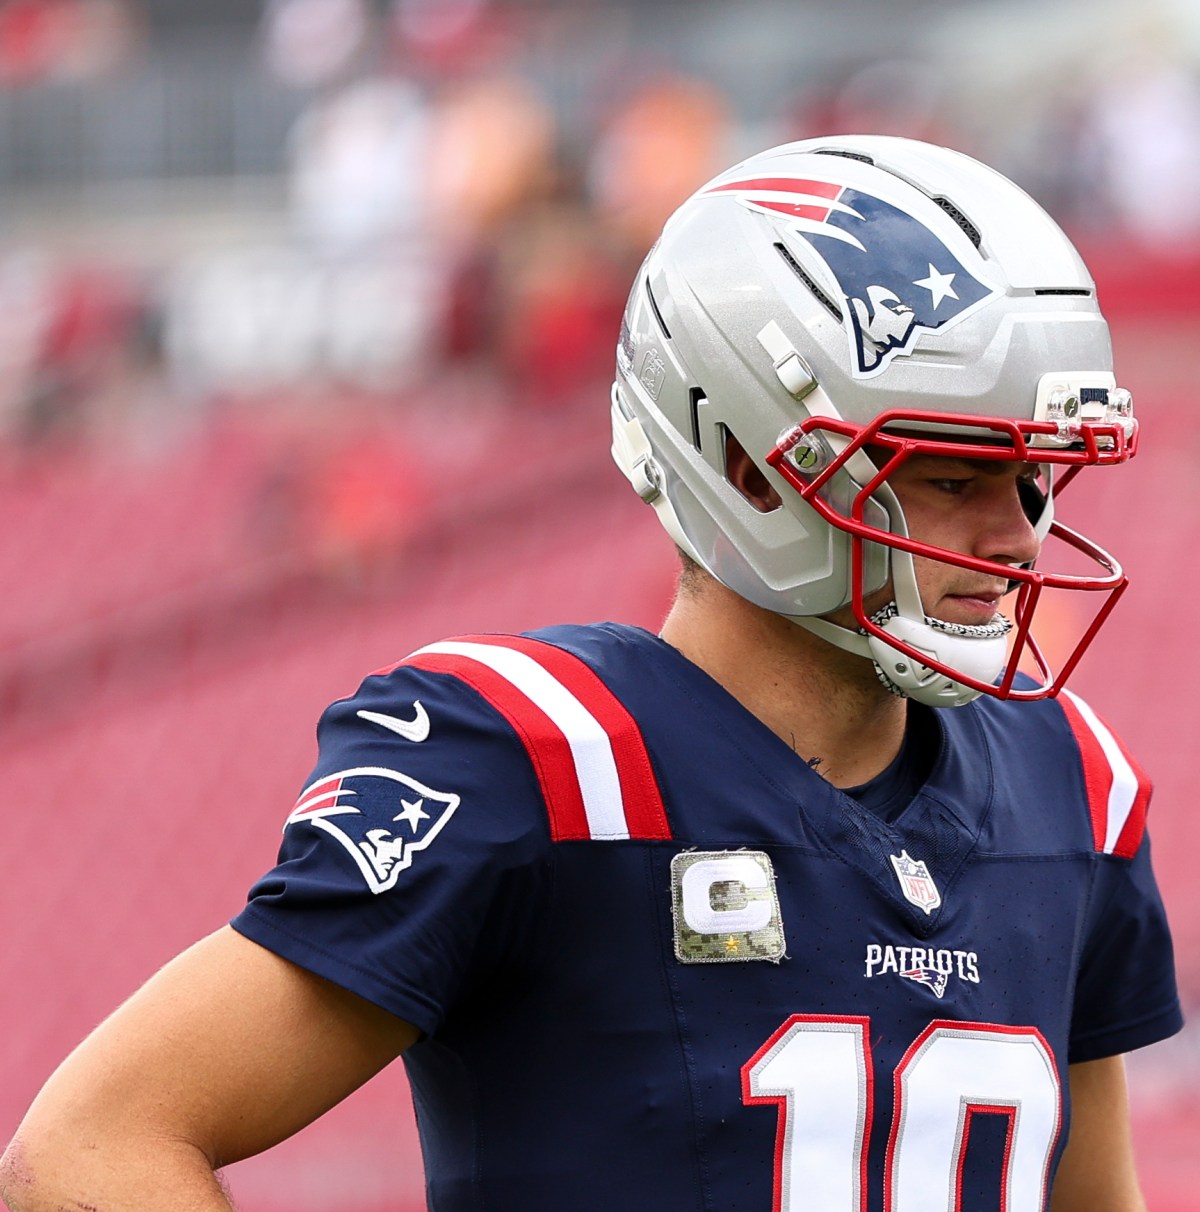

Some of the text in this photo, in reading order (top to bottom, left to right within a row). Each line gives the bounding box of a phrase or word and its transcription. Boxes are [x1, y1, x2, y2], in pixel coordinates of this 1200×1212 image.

[681, 859, 772, 936] C
[905, 876, 935, 903] NFL
[864, 942, 981, 984] PATRIOTS
